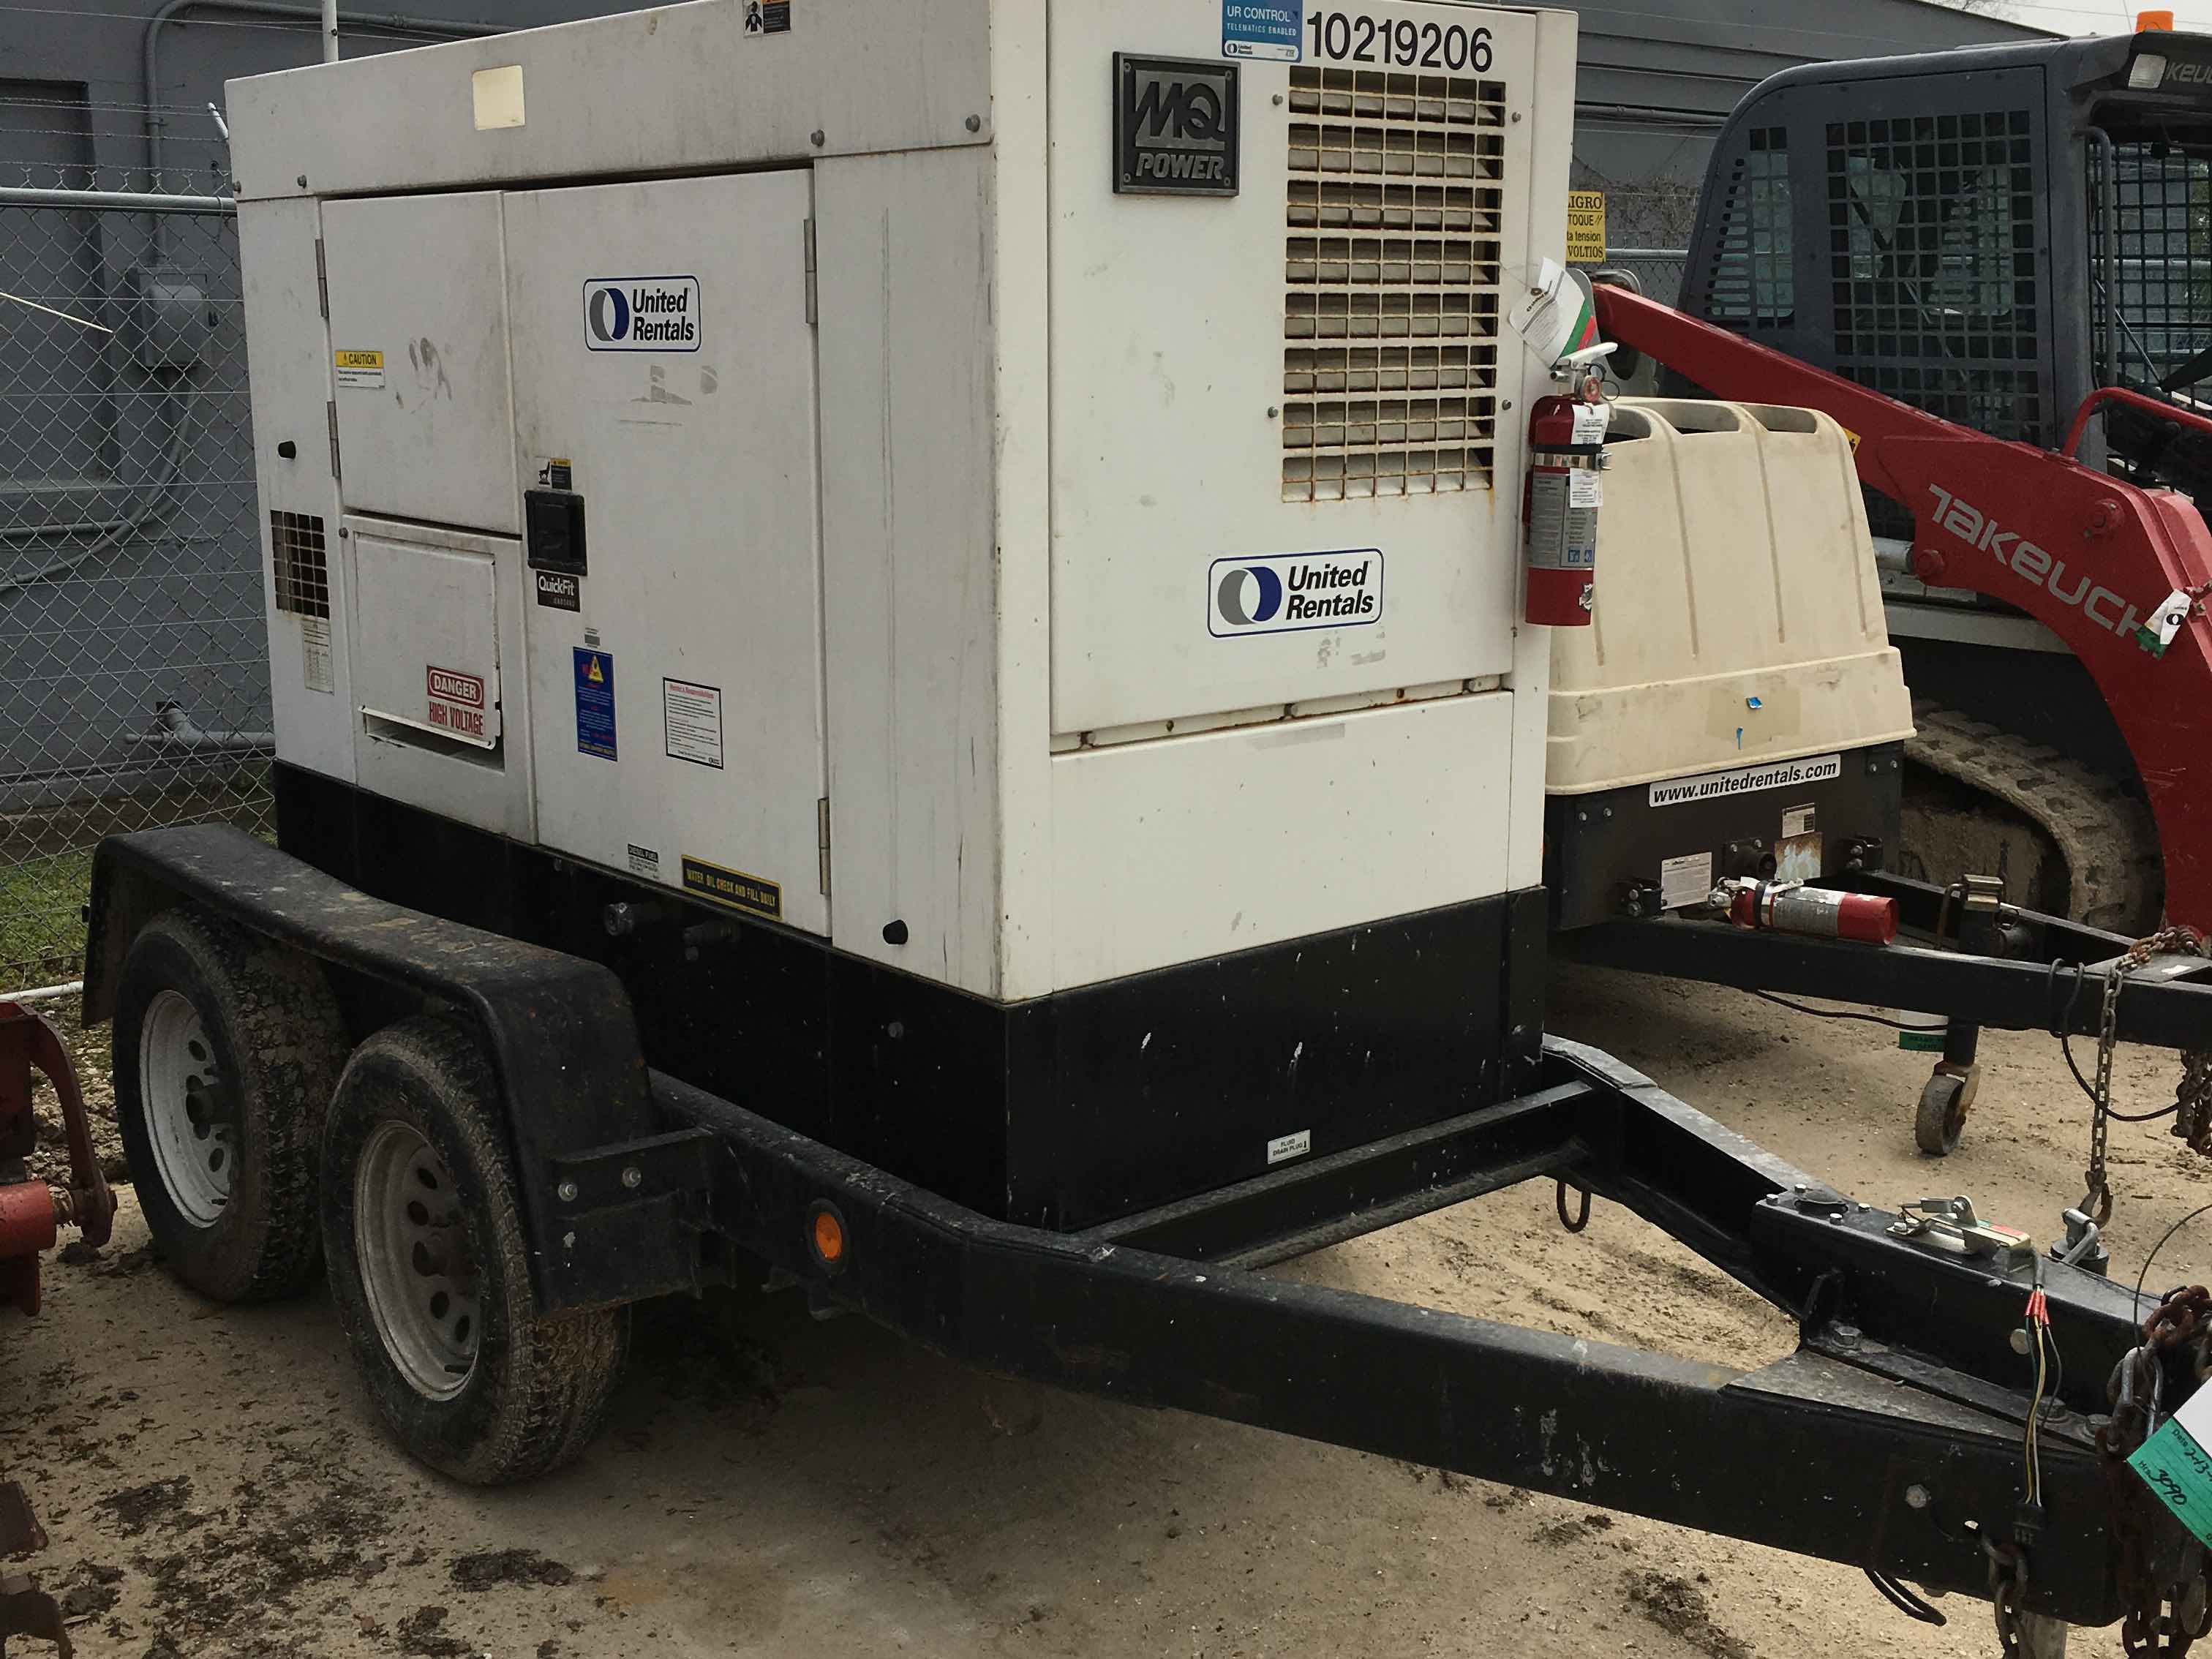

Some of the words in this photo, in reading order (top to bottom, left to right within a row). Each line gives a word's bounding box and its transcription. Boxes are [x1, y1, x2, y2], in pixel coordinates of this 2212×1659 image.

[1227, 6, 1241, 18] UR
[1244, 7, 1291, 22] CONTROL
[1227, 23, 1265, 34] TELEMATICS
[1268, 26, 1297, 36] ENABLED
[1307, 11, 1493, 72] 10219206
[1134, 81, 1226, 141] MQ
[1135, 152, 1224, 180] POWER
[1567, 245, 1604, 258] VOLTIOS
[633, 287, 689, 313] United
[633, 315, 694, 341] Rentals
[348, 353, 377, 365] CAUTION
[538, 575, 574, 597] QuickFit
[1287, 560, 1370, 592] United
[1285, 589, 1374, 621] Rentals
[434, 674, 477, 699] DANGER
[429, 701, 448, 726] HIGH
[450, 706, 484, 736] VOLTAGE
[1653, 760, 1837, 803] www.unitedrentals.com
